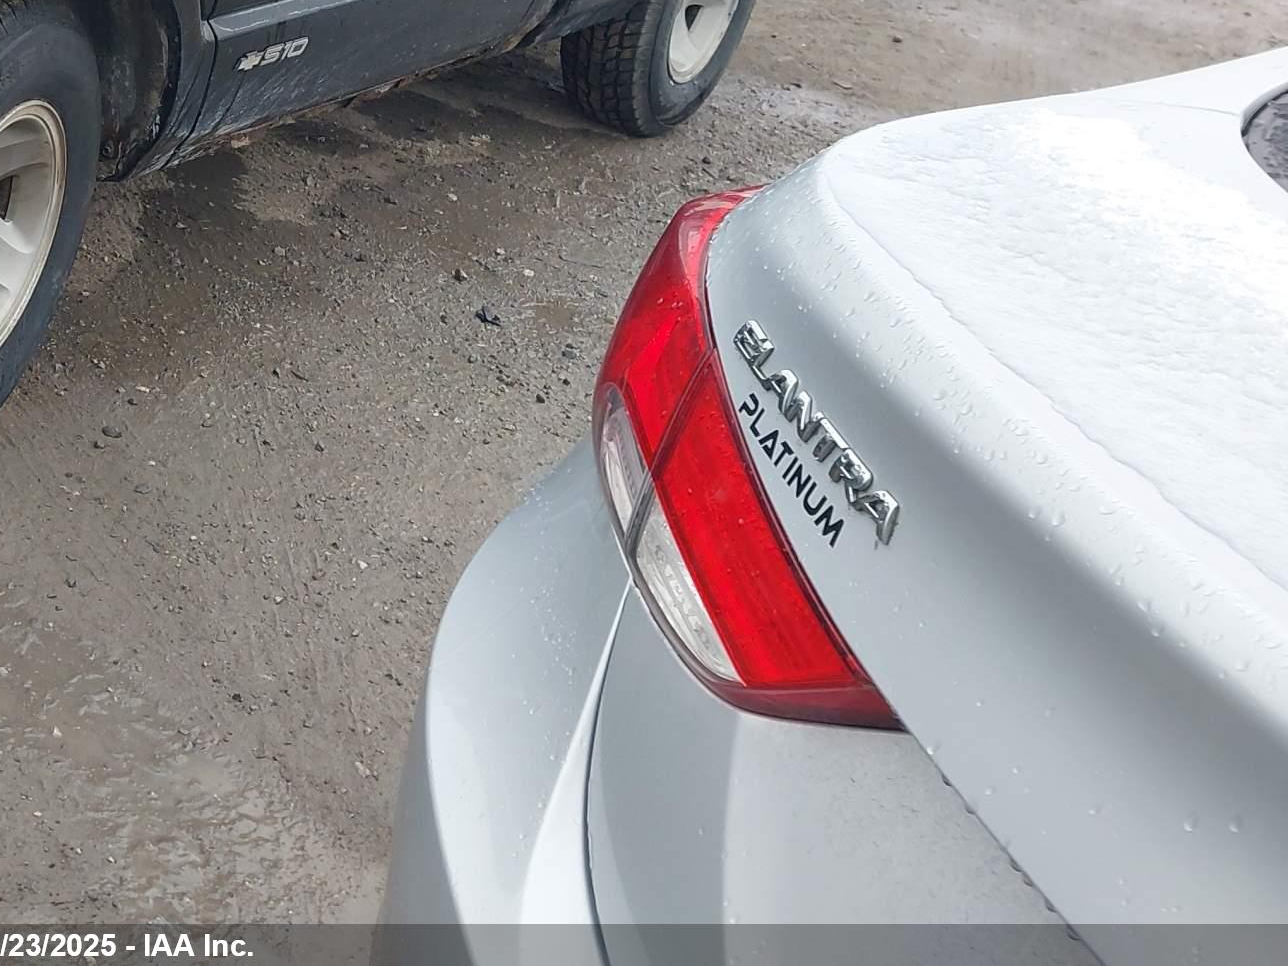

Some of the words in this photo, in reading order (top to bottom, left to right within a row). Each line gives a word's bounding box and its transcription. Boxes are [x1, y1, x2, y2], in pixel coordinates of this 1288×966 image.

[259, 36, 309, 66] S10
[733, 320, 899, 546] ELANTRA
[738, 393, 845, 548] PLATINUM
